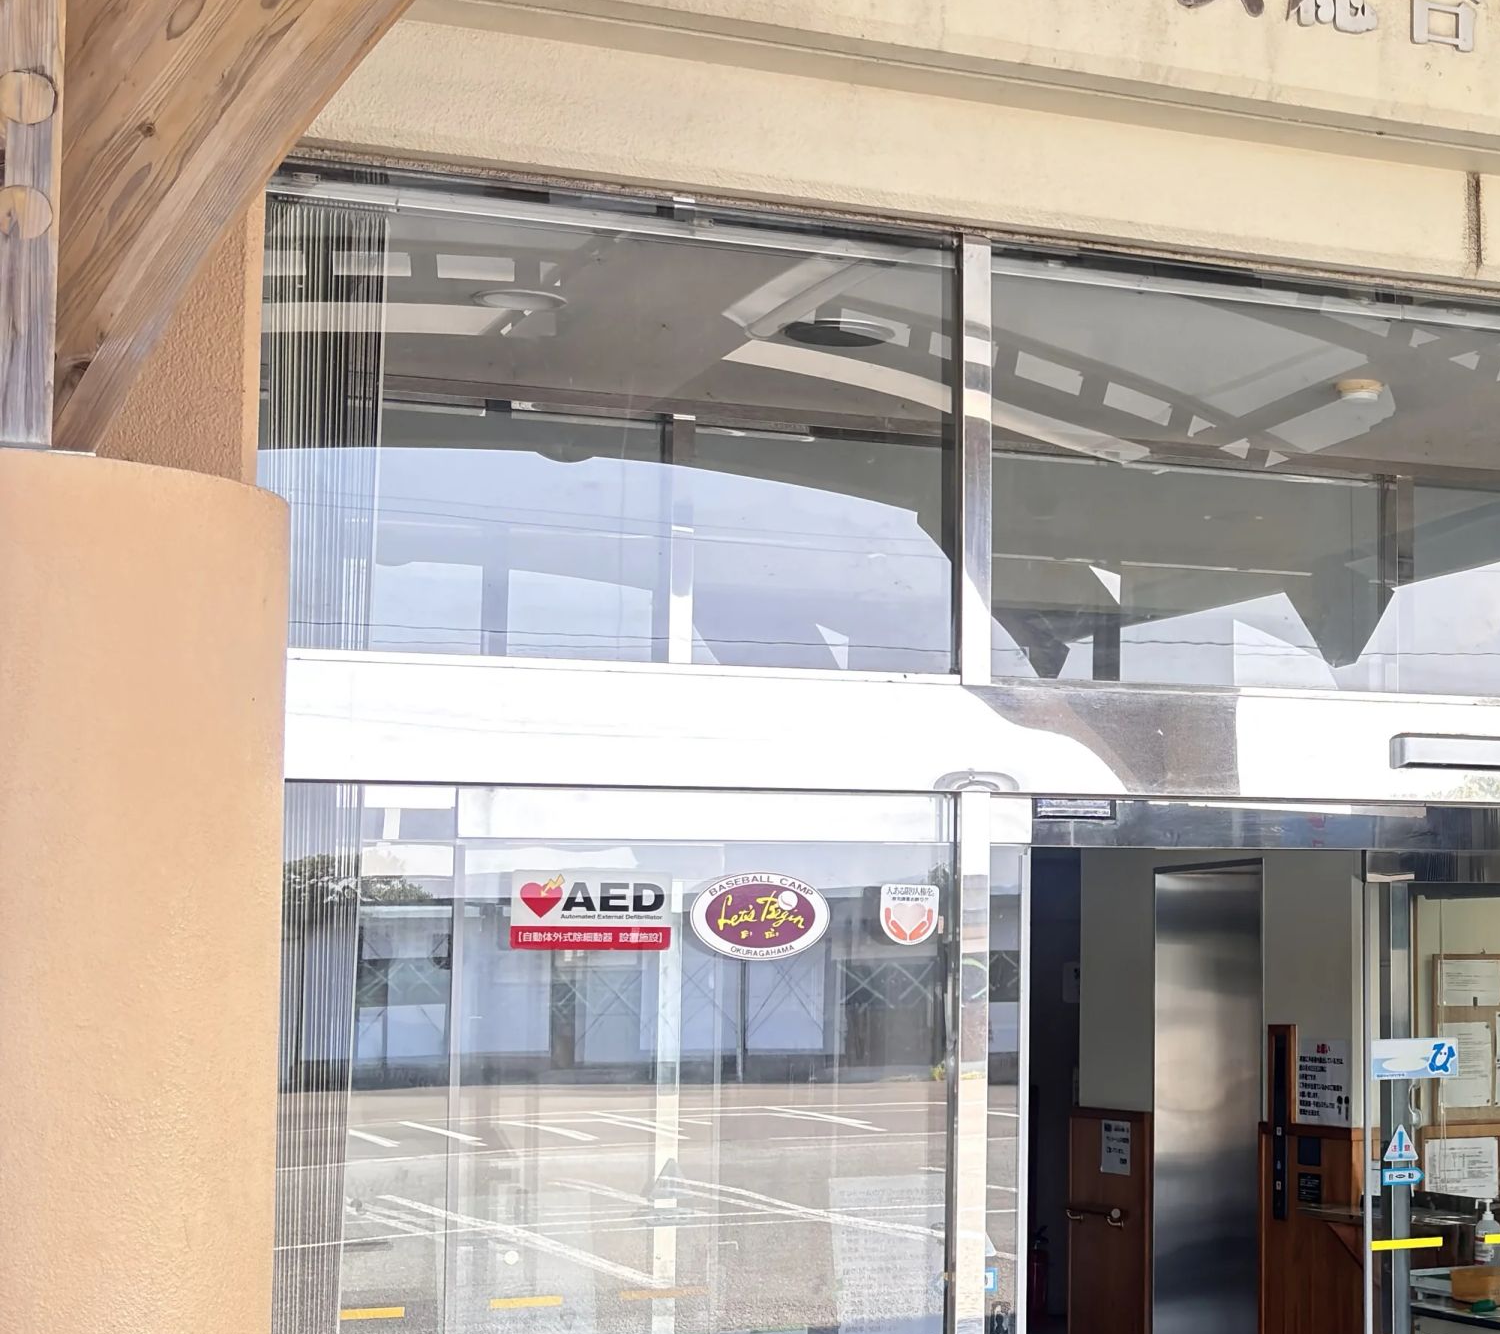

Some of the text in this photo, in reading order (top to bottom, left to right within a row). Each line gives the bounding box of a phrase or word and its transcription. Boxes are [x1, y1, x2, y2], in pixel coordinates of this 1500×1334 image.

[561, 882, 665, 912] AED
[708, 875, 814, 897] BASEBALL CAMP
[717, 890, 806, 931] Let's Begin
[730, 944, 796, 958] OKURAGAHAMA
